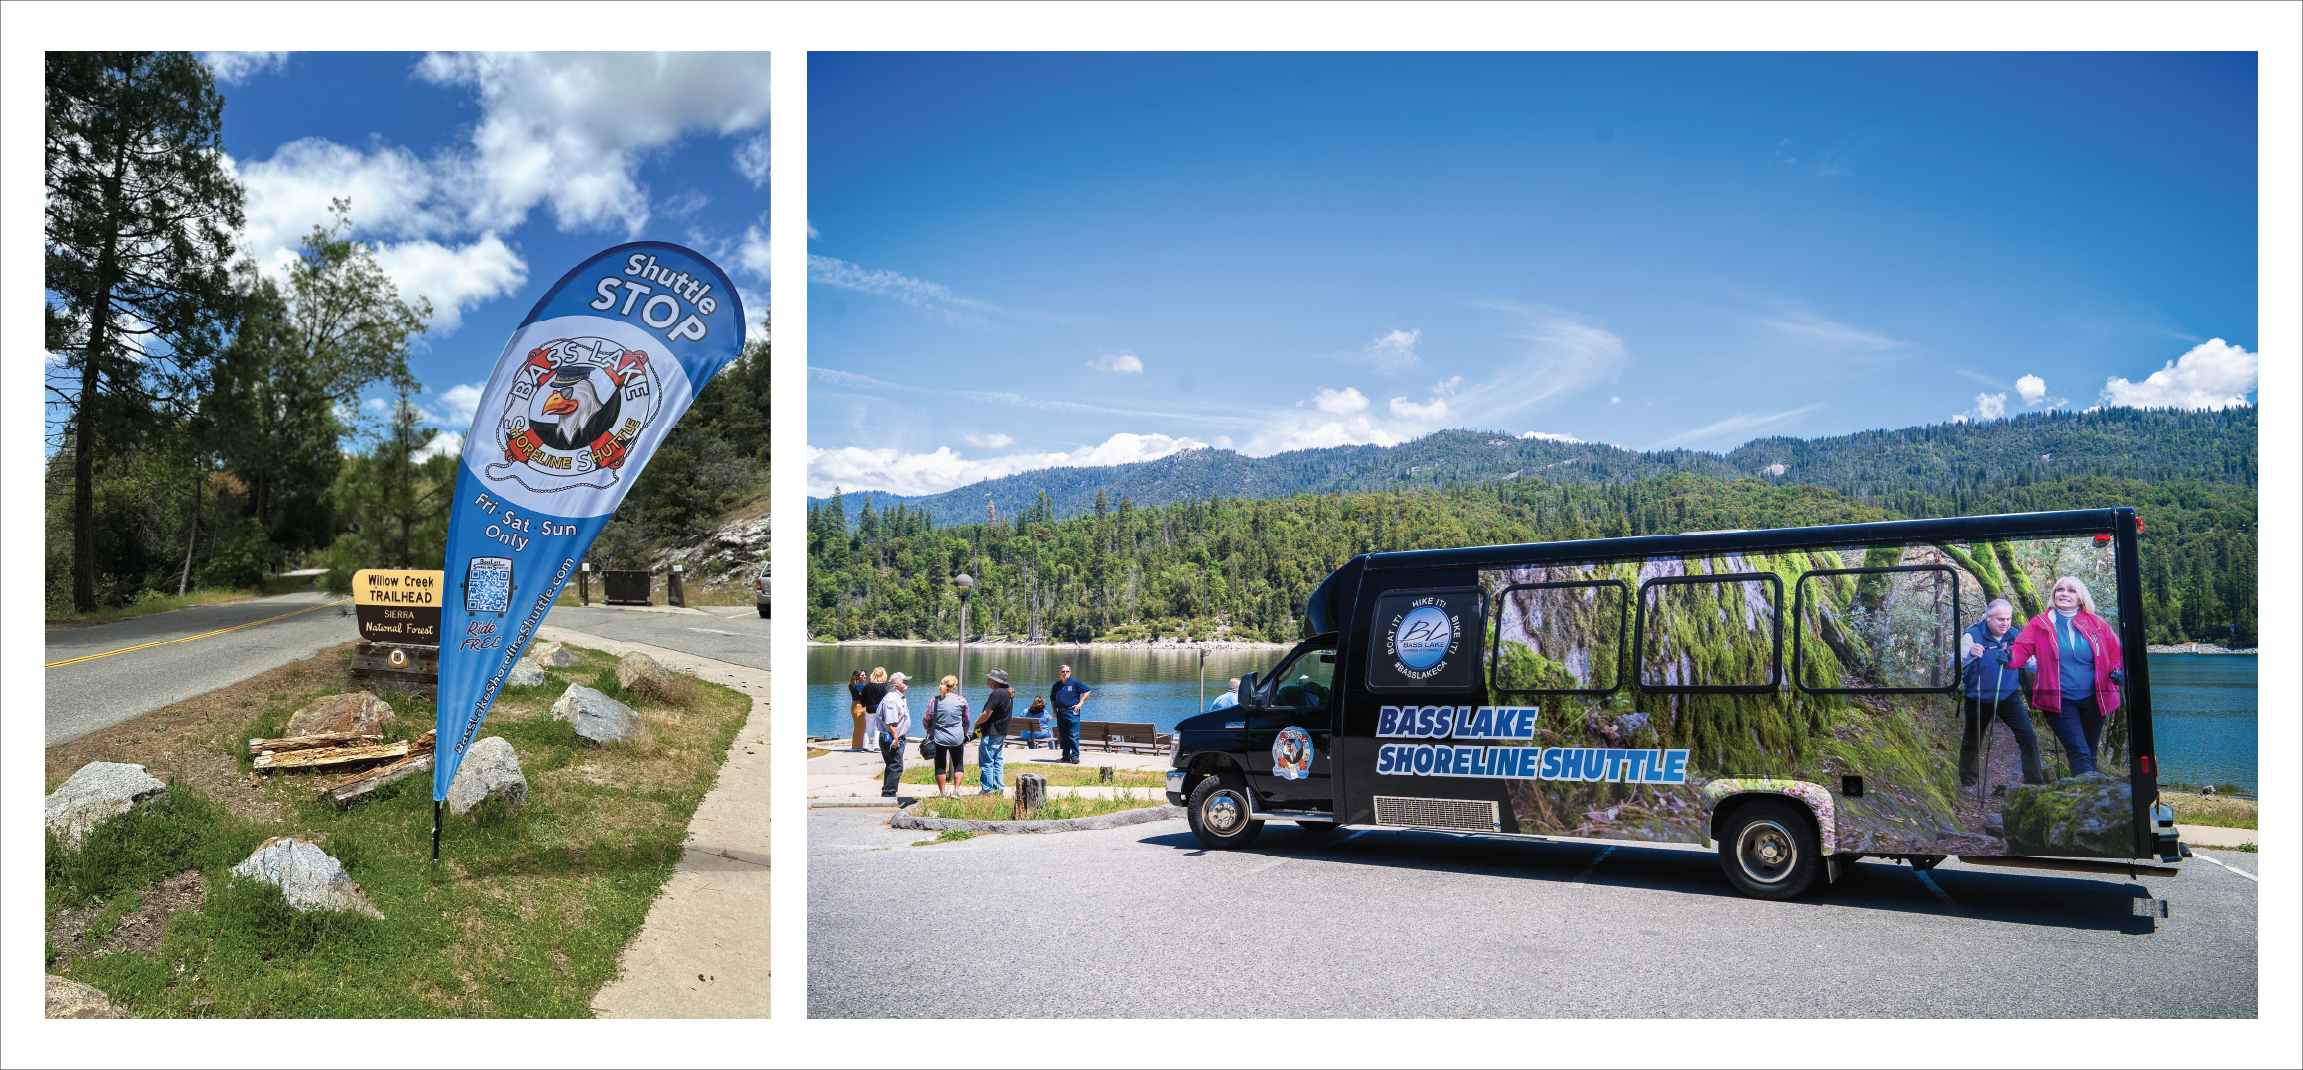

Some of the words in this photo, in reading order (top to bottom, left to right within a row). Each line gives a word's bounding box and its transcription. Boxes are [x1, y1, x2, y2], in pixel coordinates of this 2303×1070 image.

[624, 253, 717, 315] Shuttle
[589, 276, 708, 343] STOP
[513, 341, 579, 400] BASS
[588, 341, 650, 401] LAKE
[505, 416, 572, 469] SHORELINE
[576, 417, 641, 471] SHUTTLE
[474, 492, 499, 515] Fri
[502, 509, 530, 533] Sat
[541, 521, 578, 536] Sun
[485, 524, 530, 552] Only
[368, 574, 399, 587] Willow
[404, 575, 434, 588] Creek
[370, 590, 432, 604] TRAILHEAD
[1412, 597, 1434, 608] HIKE
[1435, 598, 1447, 608] IT!
[384, 609, 415, 620] SIERRA
[1451, 615, 1461, 639] BIKE
[365, 621, 403, 634] National
[406, 623, 434, 636] Forest
[466, 619, 498, 637] Ride
[1386, 629, 1396, 655] BOAT
[1391, 614, 1403, 628] IT!
[454, 557, 575, 755] BassLakeShorelineShuttle.com
[460, 636, 503, 652] FREE
[1448, 641, 1459, 655] IT!
[1394, 660, 1448, 680] #BASSLAKECA
[1376, 706, 1454, 739] BASS
[1452, 706, 1540, 740] LAKE
[1376, 743, 1542, 780] SHORELINE
[1539, 747, 1691, 784] SHUTTLE
